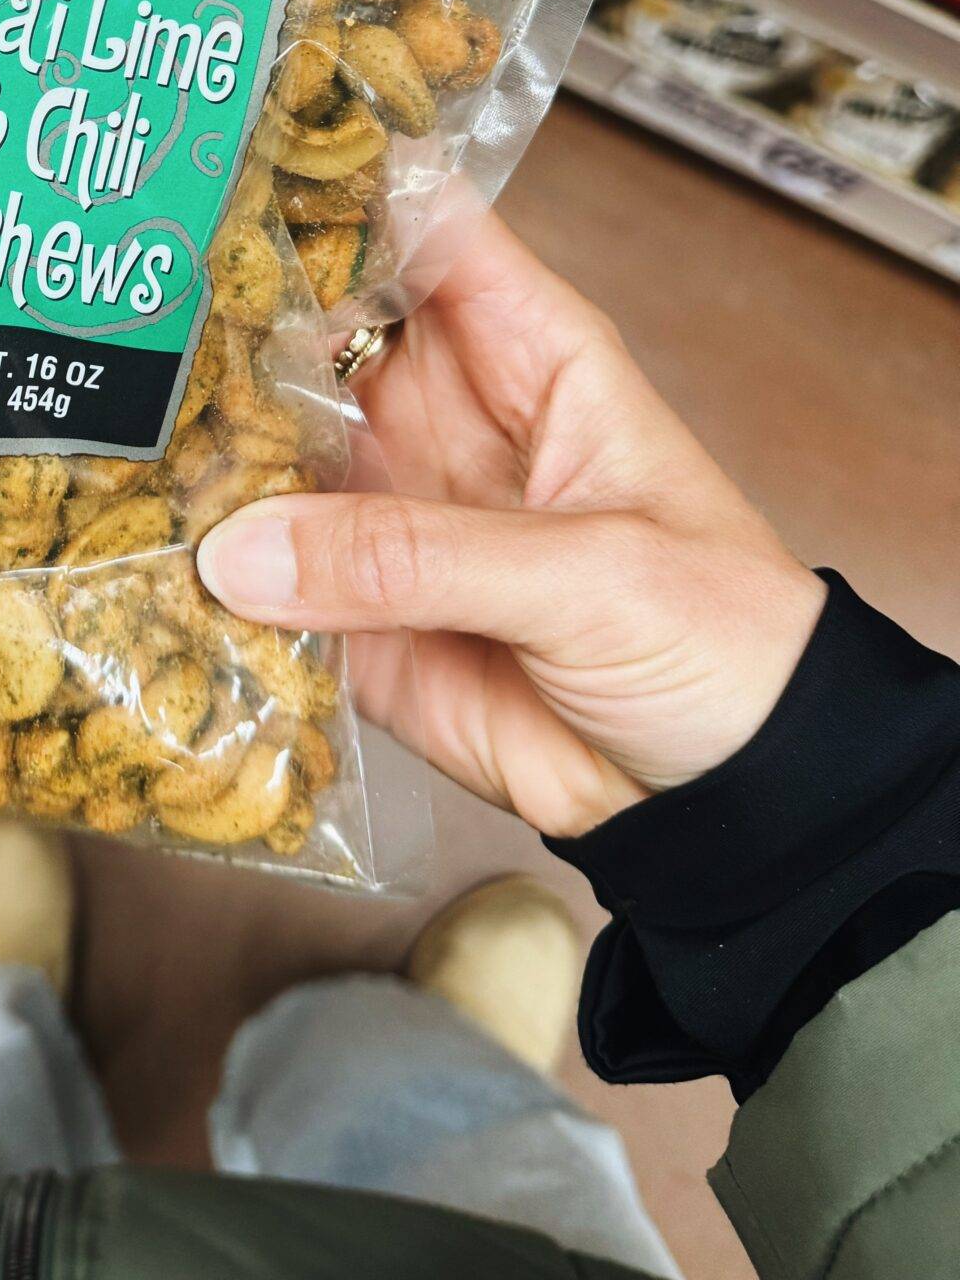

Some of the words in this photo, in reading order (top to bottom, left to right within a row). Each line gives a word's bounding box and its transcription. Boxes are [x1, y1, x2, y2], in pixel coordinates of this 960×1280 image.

[26, 86, 152, 213] Chili
[26, 353, 59, 380] 16
[66, 361, 105, 390] OZ
[6, 385, 72, 419] 454g
